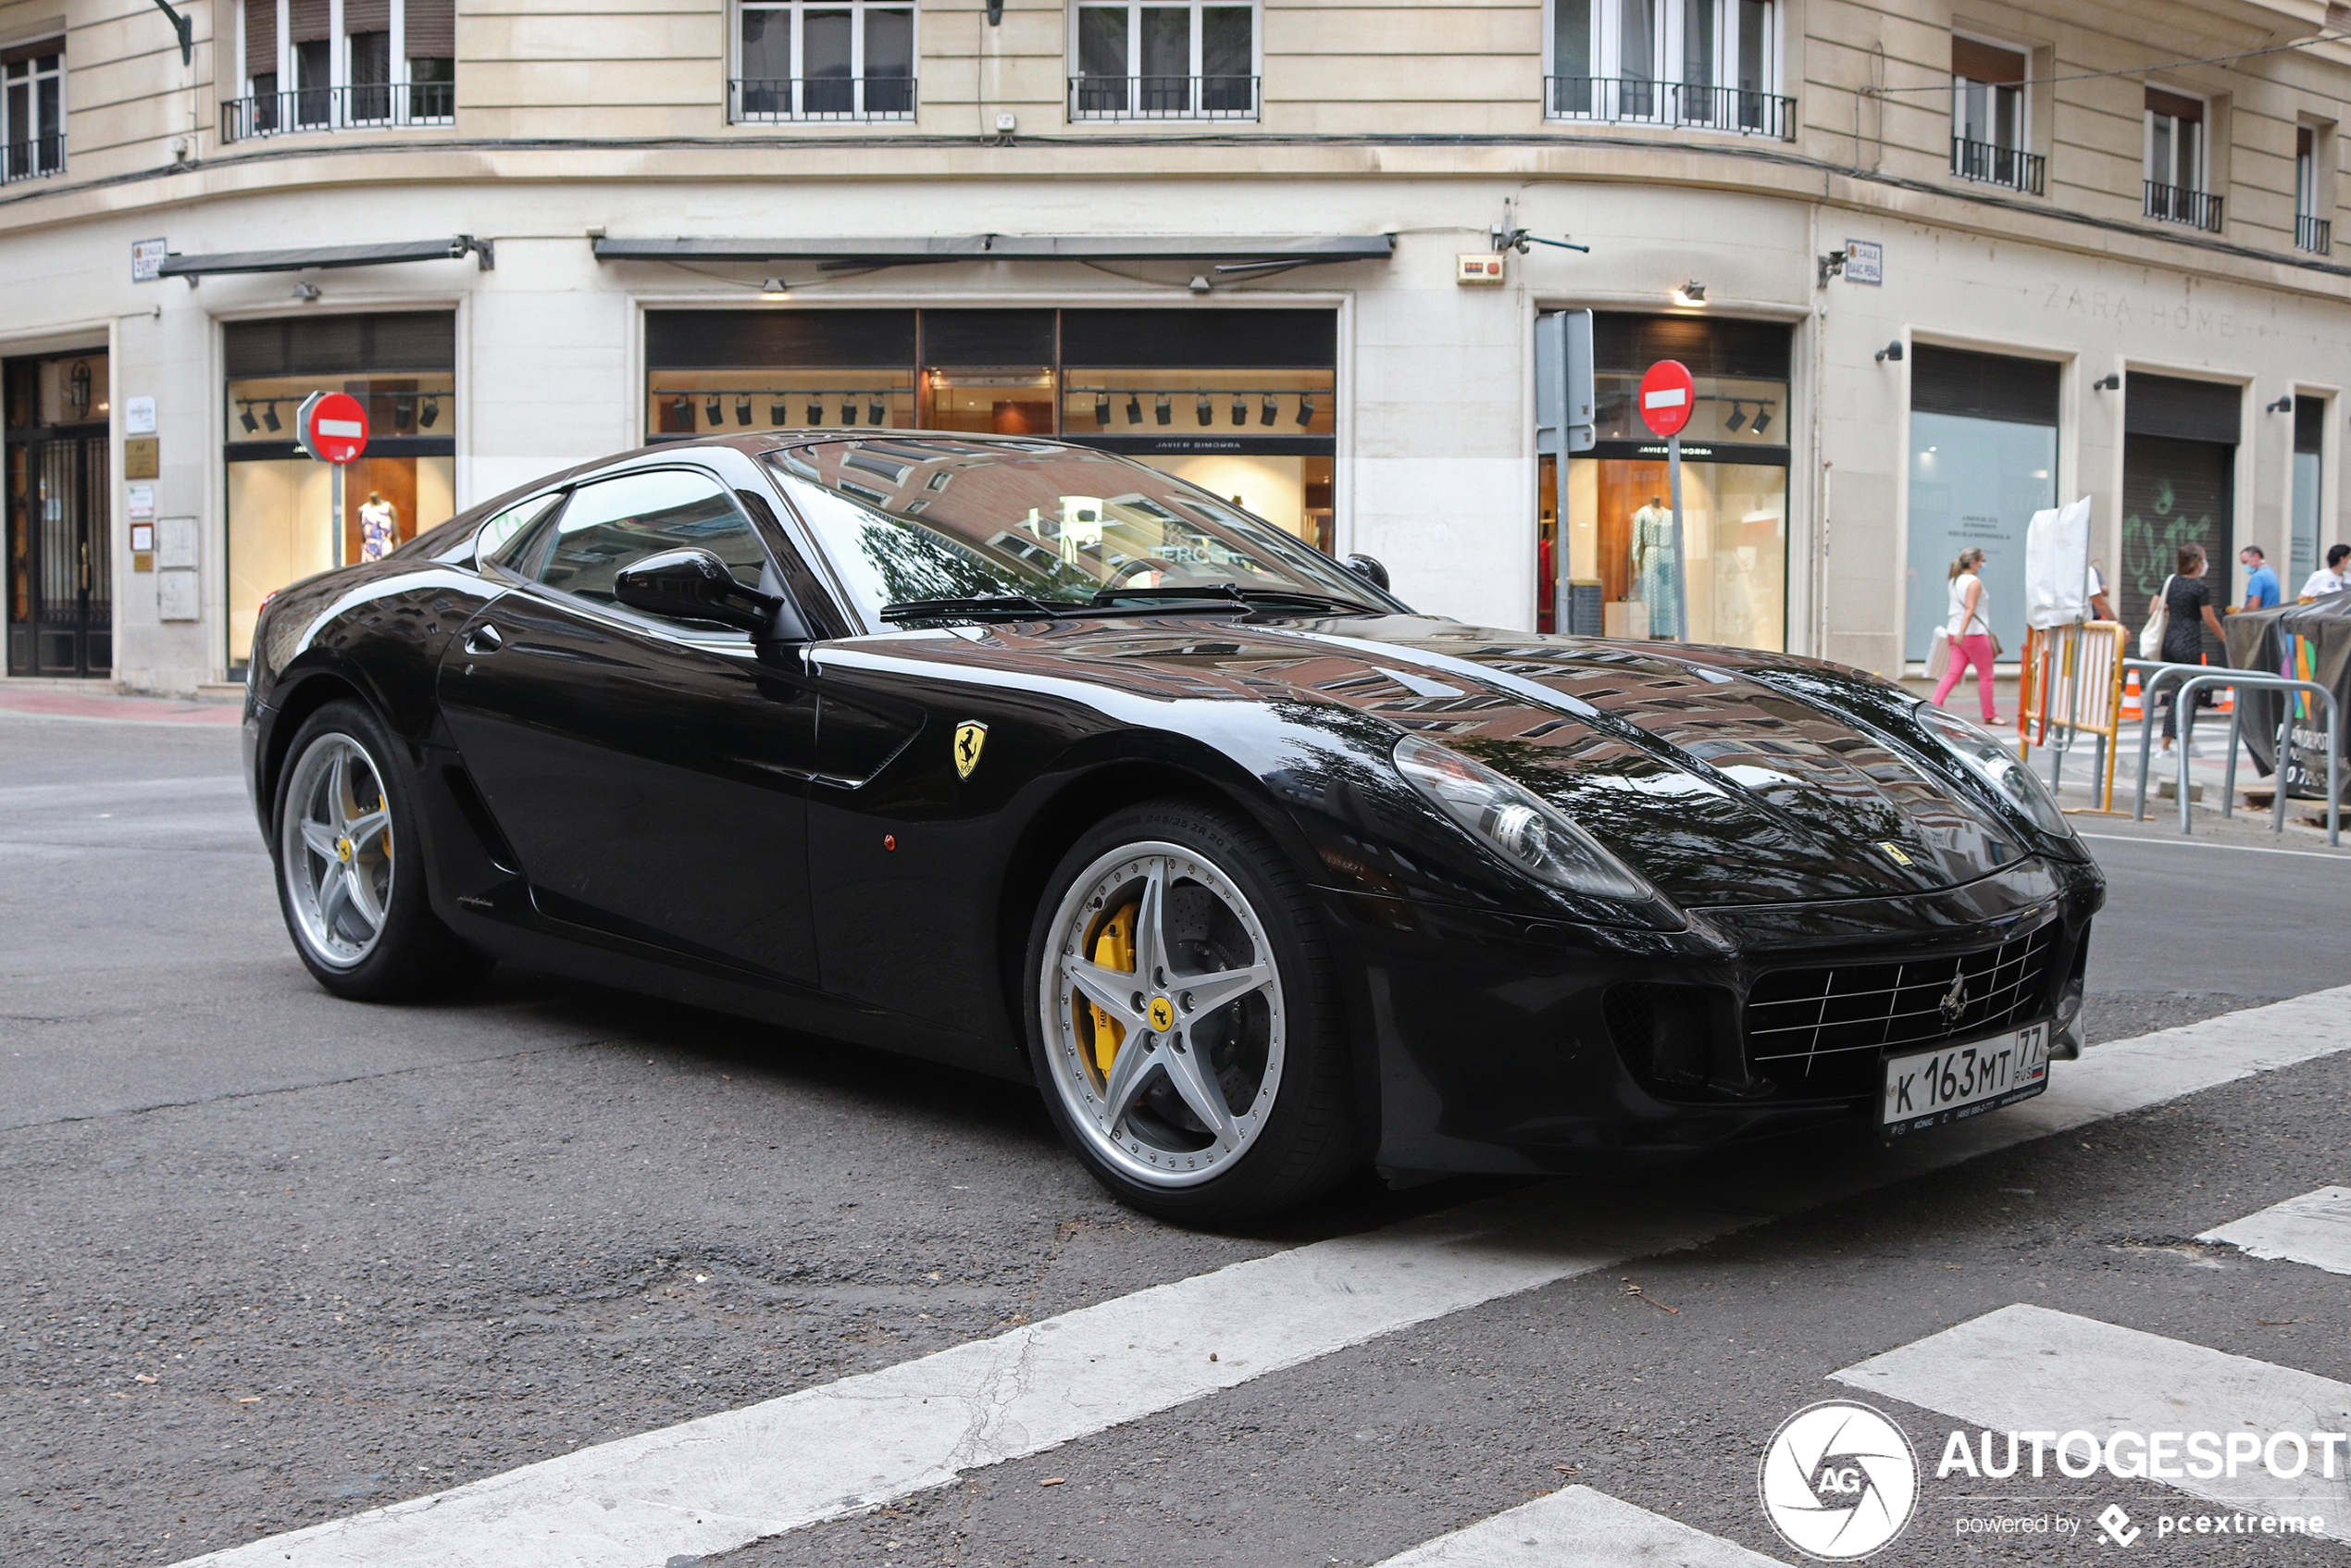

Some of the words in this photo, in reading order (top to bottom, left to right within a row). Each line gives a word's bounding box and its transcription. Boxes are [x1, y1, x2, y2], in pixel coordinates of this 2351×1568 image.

[1859, 248, 1877, 260] CALLE
[2042, 282, 2132, 321] ZARA
[2151, 302, 2233, 338] HOME
[1146, 815, 1188, 828] 245/35
[1191, 823, 1207, 837] ZR
[1208, 834, 1225, 847] 20
[2020, 1027, 2042, 1067] 77
[2014, 1068, 2032, 1082] RUS
